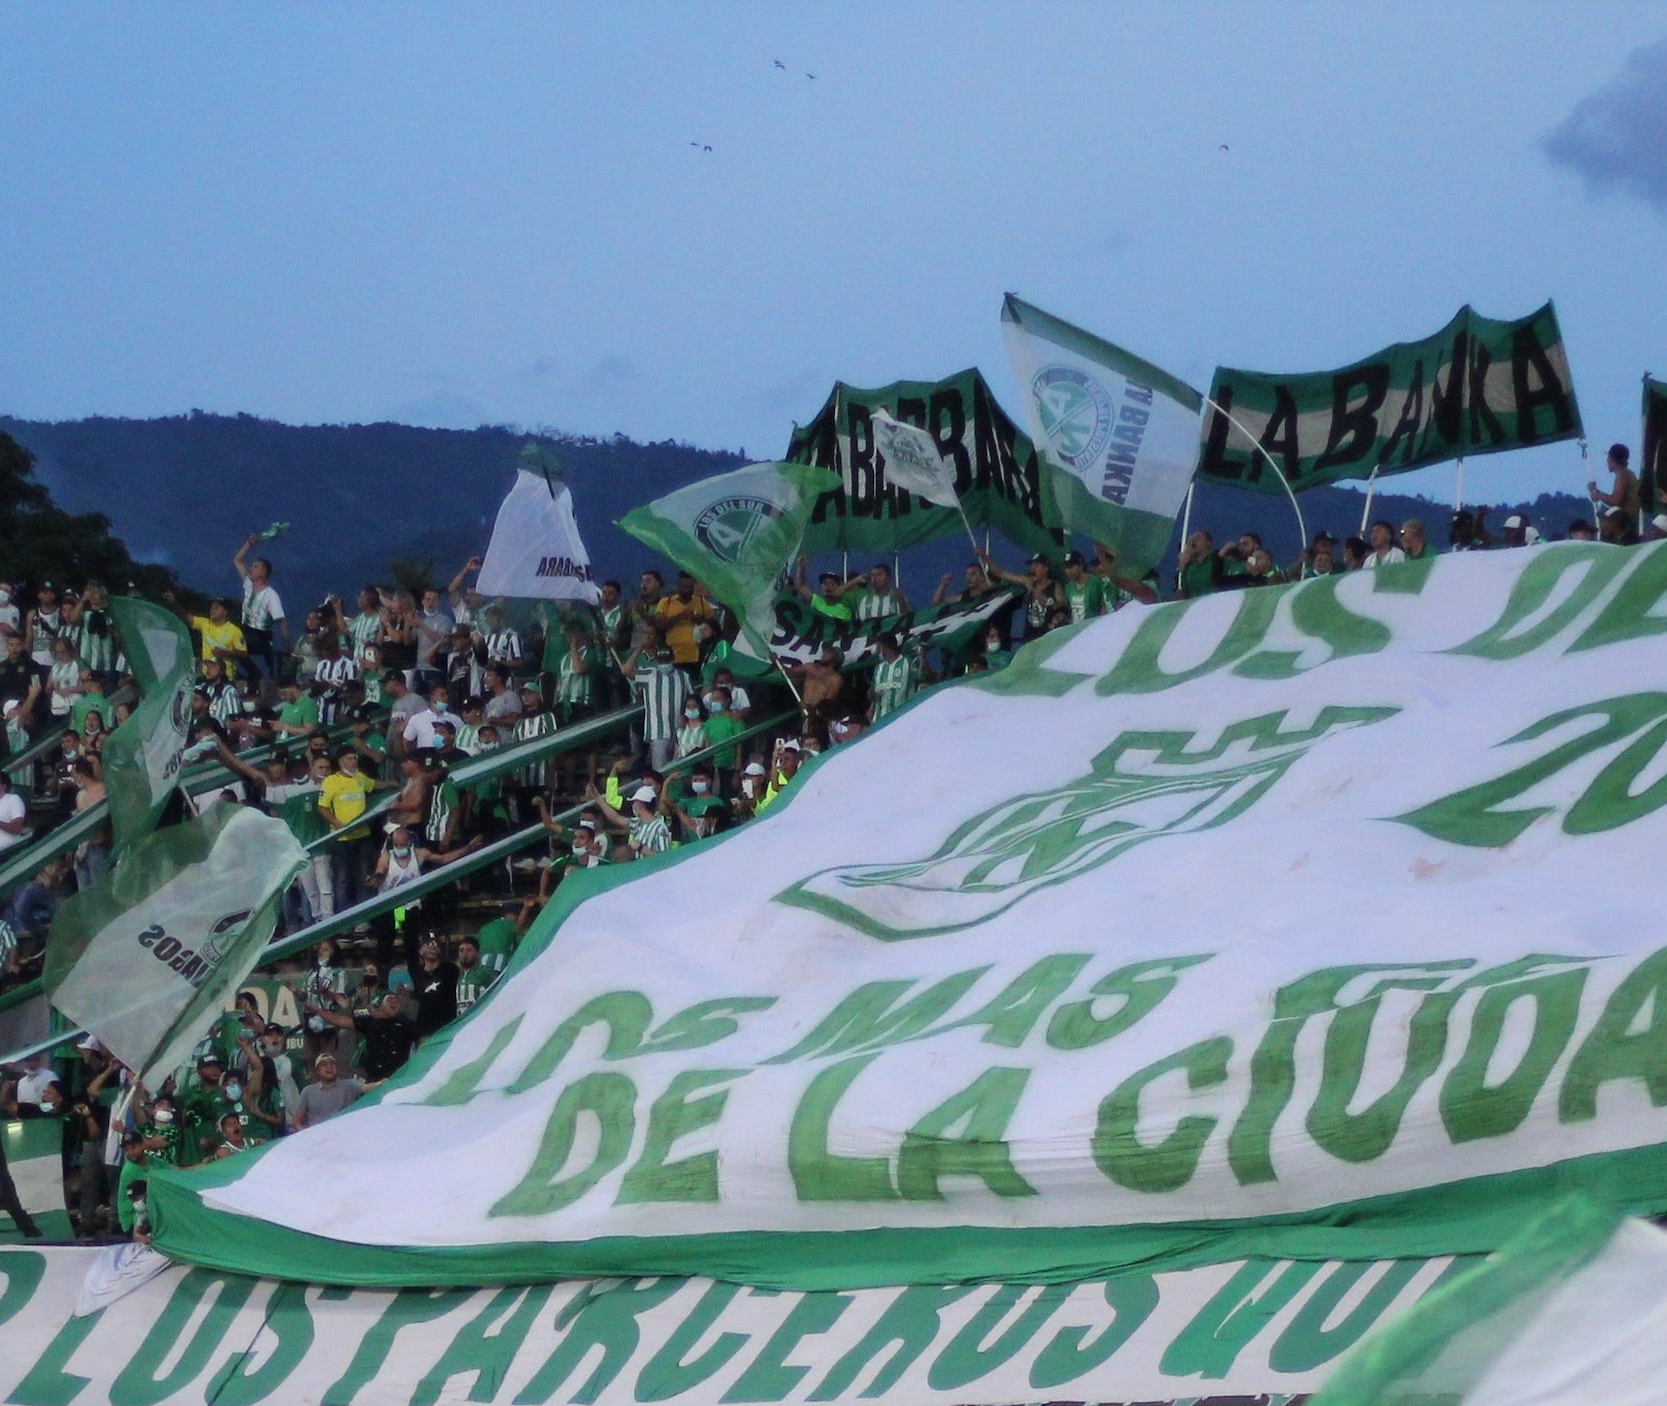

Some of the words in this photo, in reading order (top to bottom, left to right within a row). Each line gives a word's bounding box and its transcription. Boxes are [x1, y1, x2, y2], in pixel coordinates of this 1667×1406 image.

[1313, 320, 1576, 471] BANKA
[487, 1068, 755, 1219] DE
[786, 1054, 1041, 1204] LA
